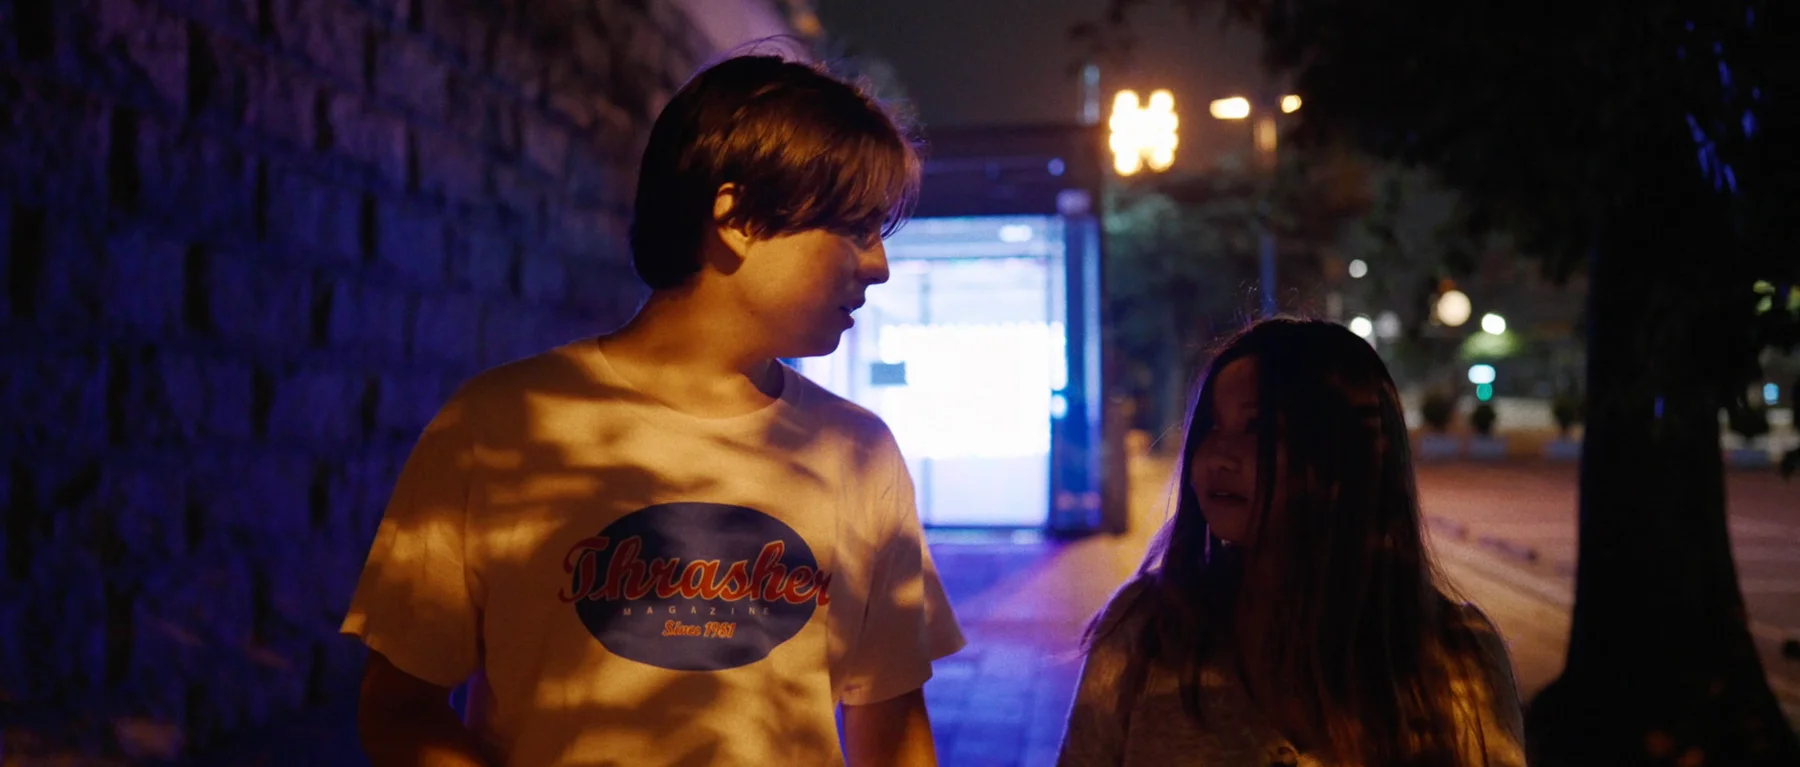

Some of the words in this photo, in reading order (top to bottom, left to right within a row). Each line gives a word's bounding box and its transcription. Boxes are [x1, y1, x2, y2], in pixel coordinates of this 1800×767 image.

[558, 535, 832, 606] Thrasher
[622, 605, 770, 616] MAGAZINE
[662, 619, 701, 637] Since
